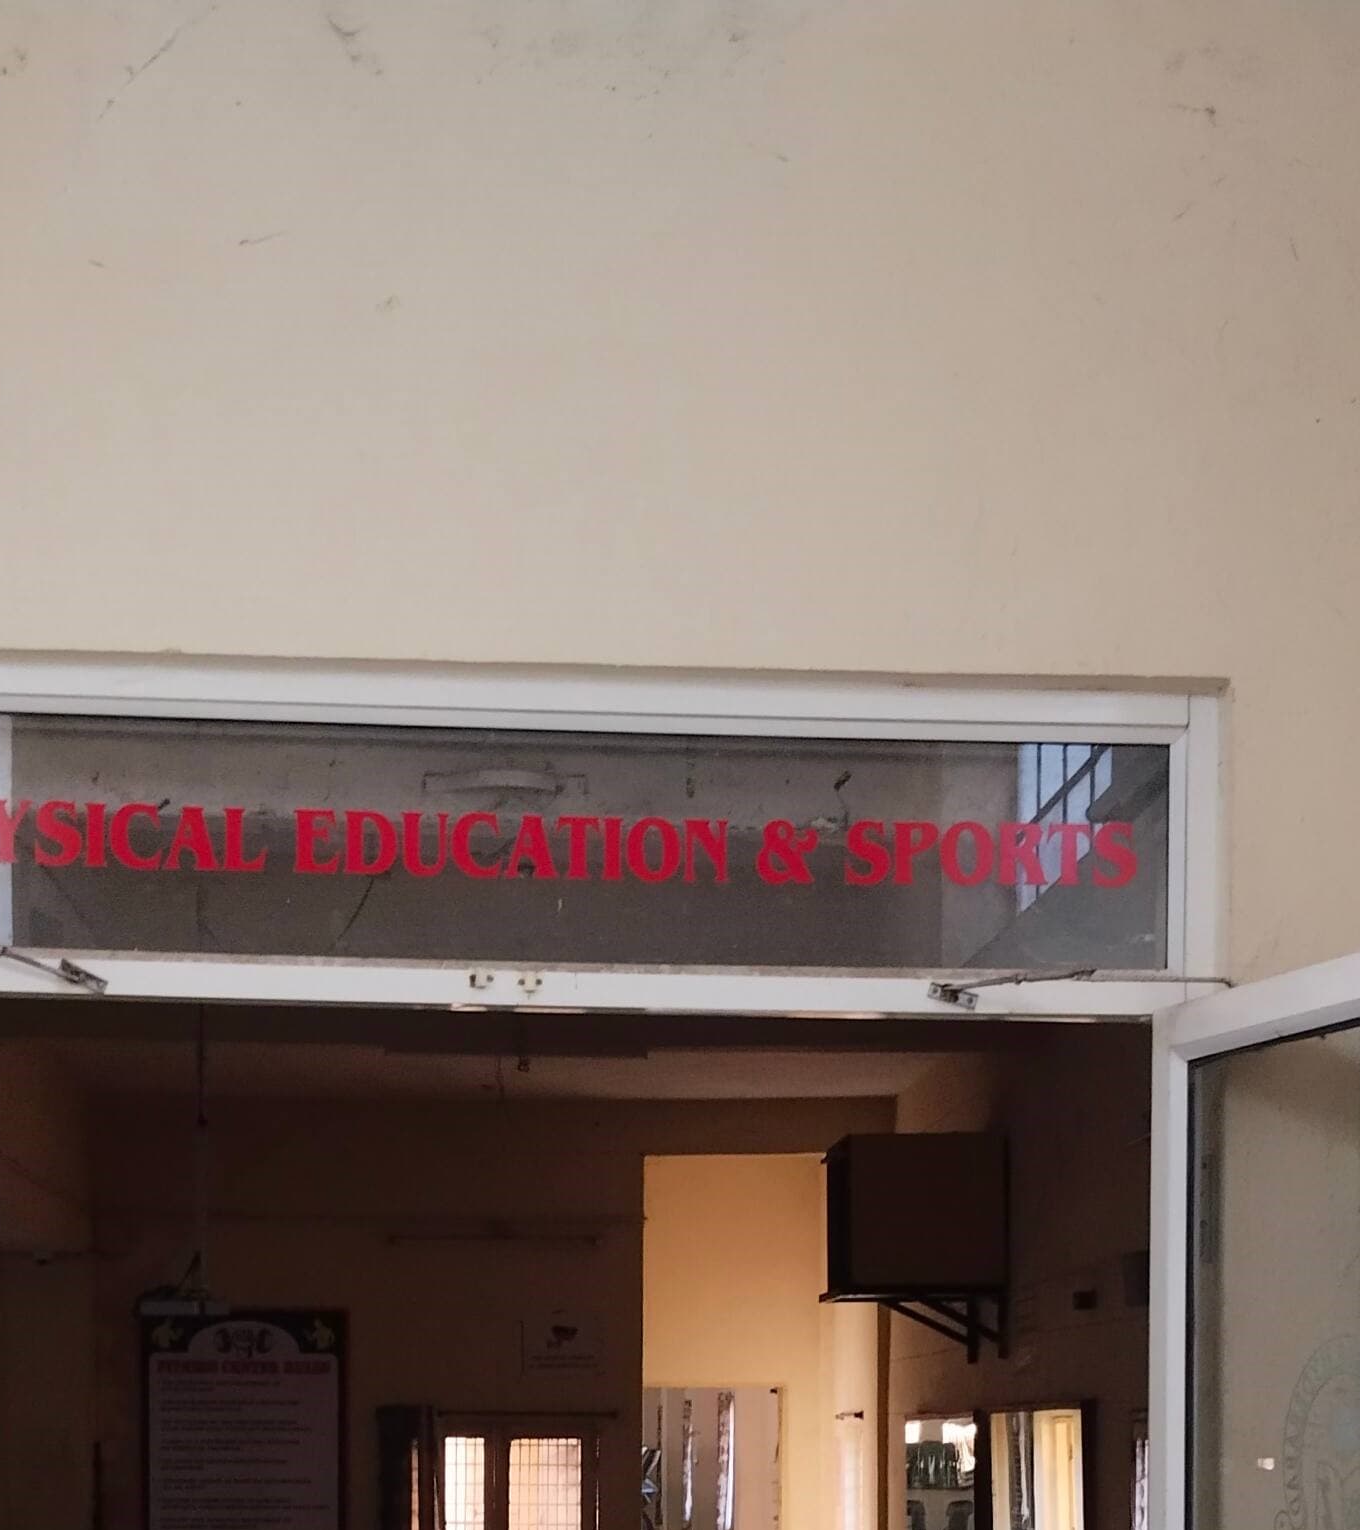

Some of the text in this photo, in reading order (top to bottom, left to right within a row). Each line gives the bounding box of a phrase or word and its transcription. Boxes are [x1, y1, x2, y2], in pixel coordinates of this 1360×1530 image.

[294, 807, 730, 884] EDUCATION
[755, 819, 820, 887] &
[845, 819, 1139, 888] SPORTS
